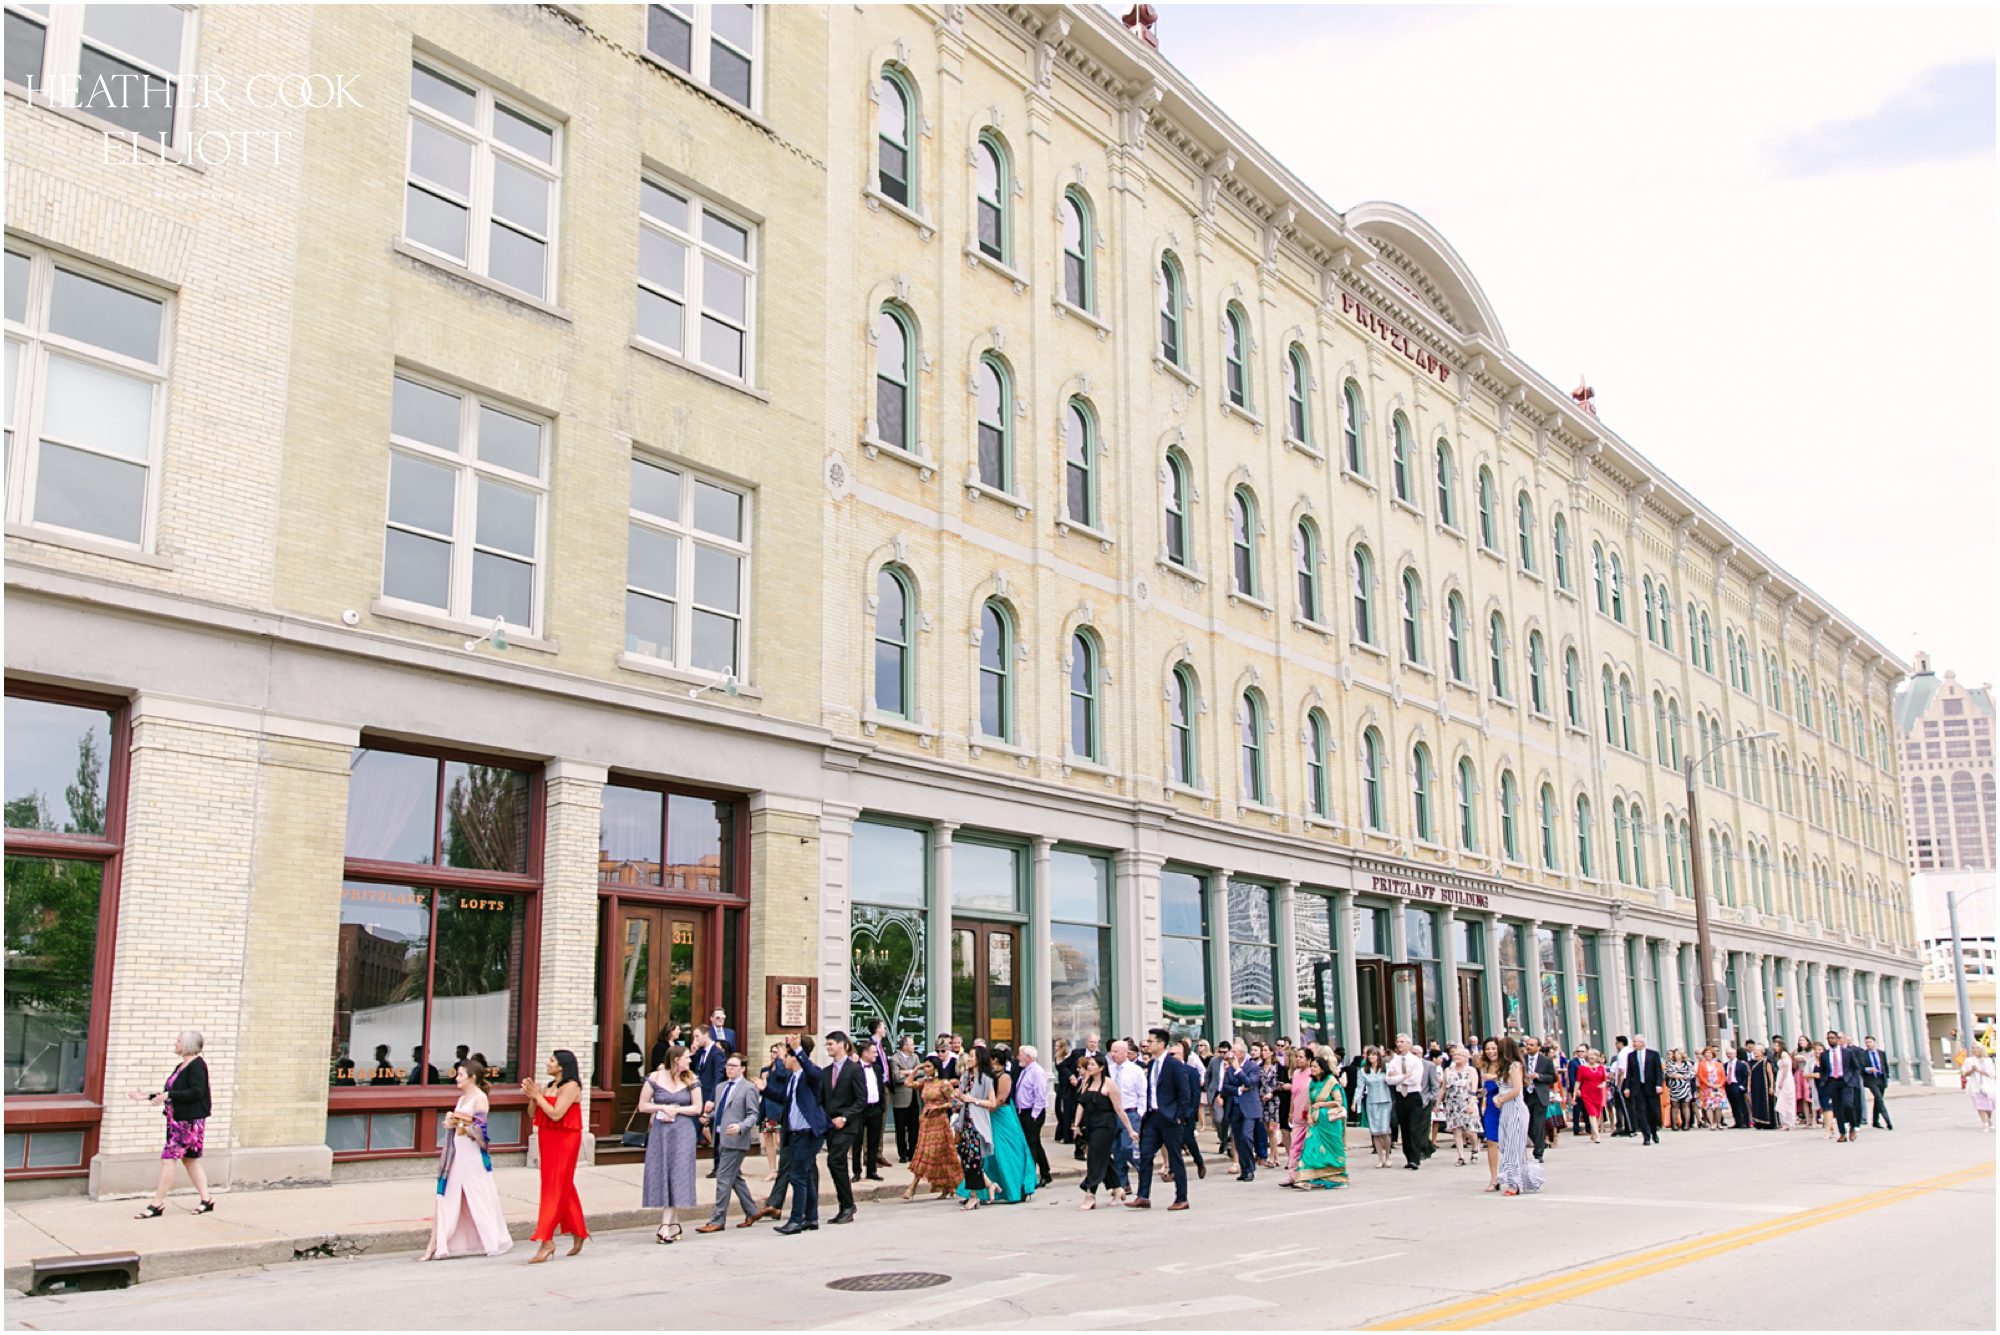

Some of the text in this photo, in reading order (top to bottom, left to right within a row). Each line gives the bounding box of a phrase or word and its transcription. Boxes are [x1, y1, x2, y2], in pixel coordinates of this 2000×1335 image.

[1371, 876, 1489, 908] PRITZLAFF BUILDING
[460, 898, 504, 911] LOFTS
[672, 931, 694, 945] 311
[337, 1067, 406, 1079] LEASING
